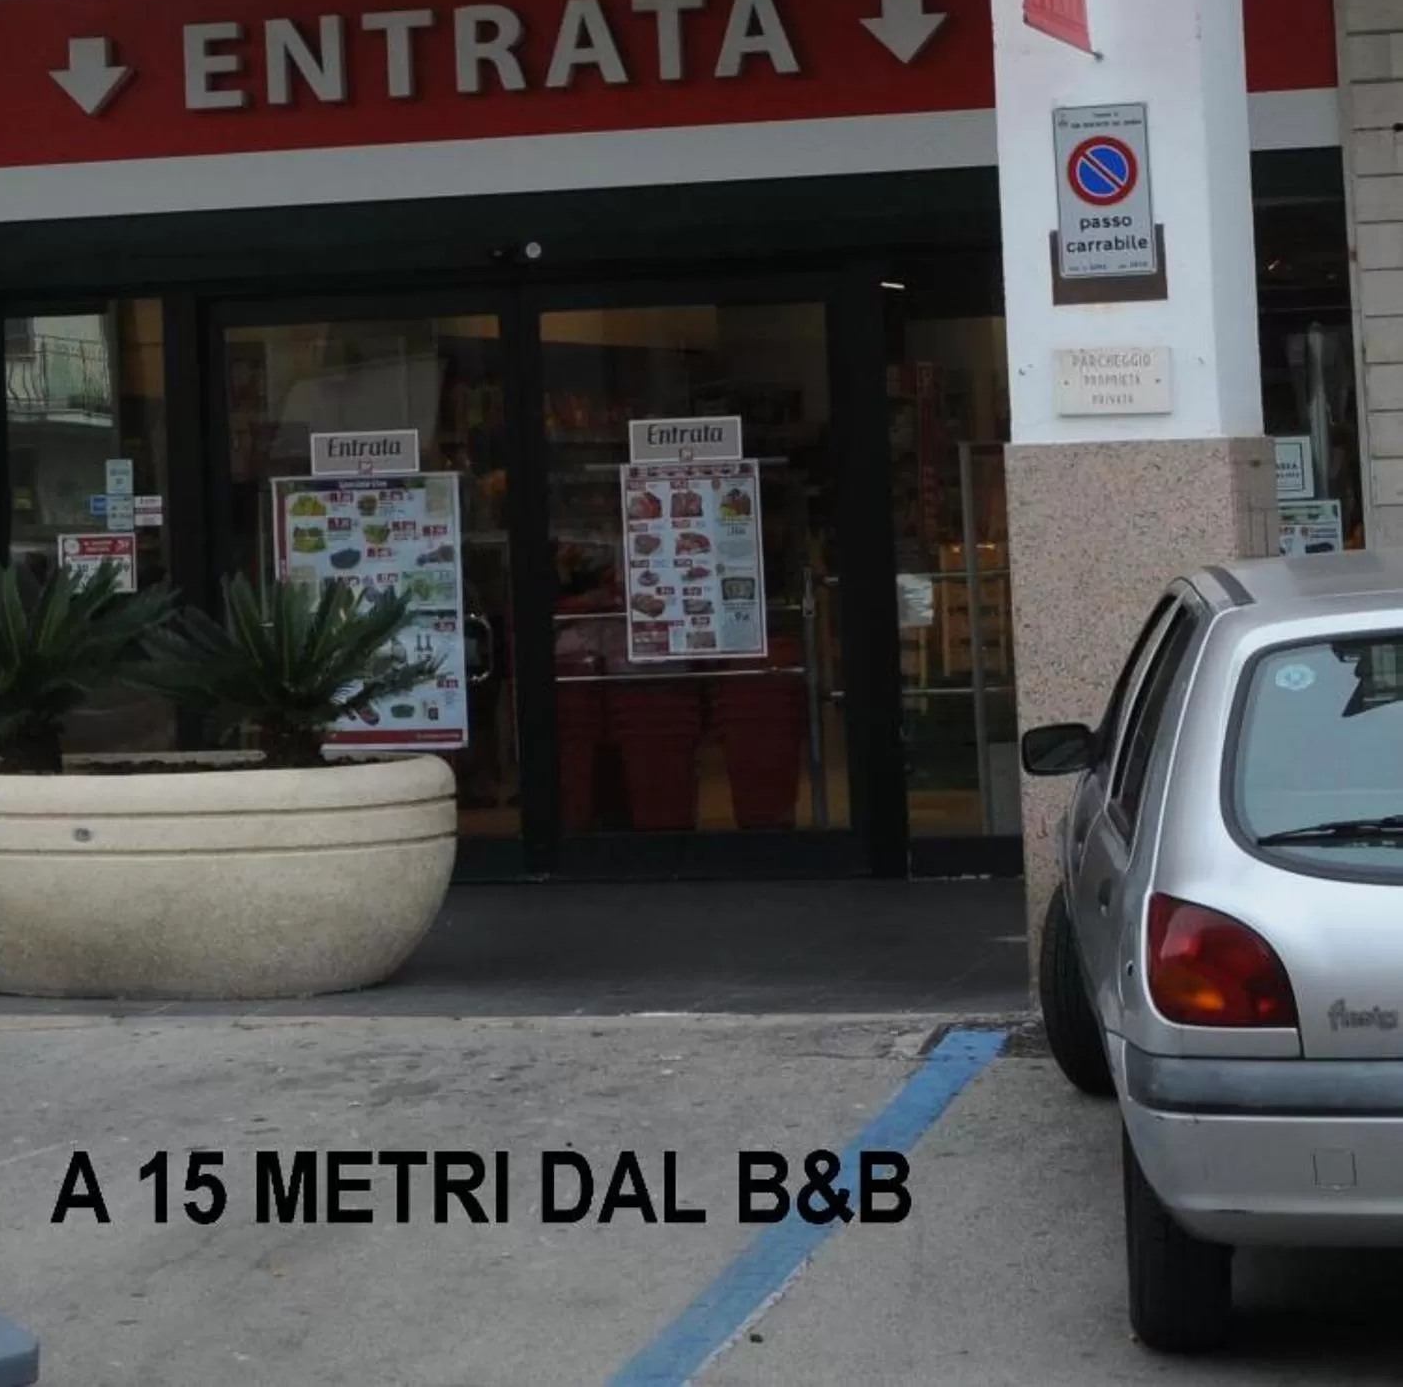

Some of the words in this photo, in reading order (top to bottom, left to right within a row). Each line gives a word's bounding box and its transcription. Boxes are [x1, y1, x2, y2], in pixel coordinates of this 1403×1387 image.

[1079, 215, 1133, 233] passo
[1066, 234, 1148, 254] carrabile
[1071, 353, 1152, 369] PARCHEGGIO
[647, 423, 723, 446] Entrata
[327, 436, 402, 458] Entrata
